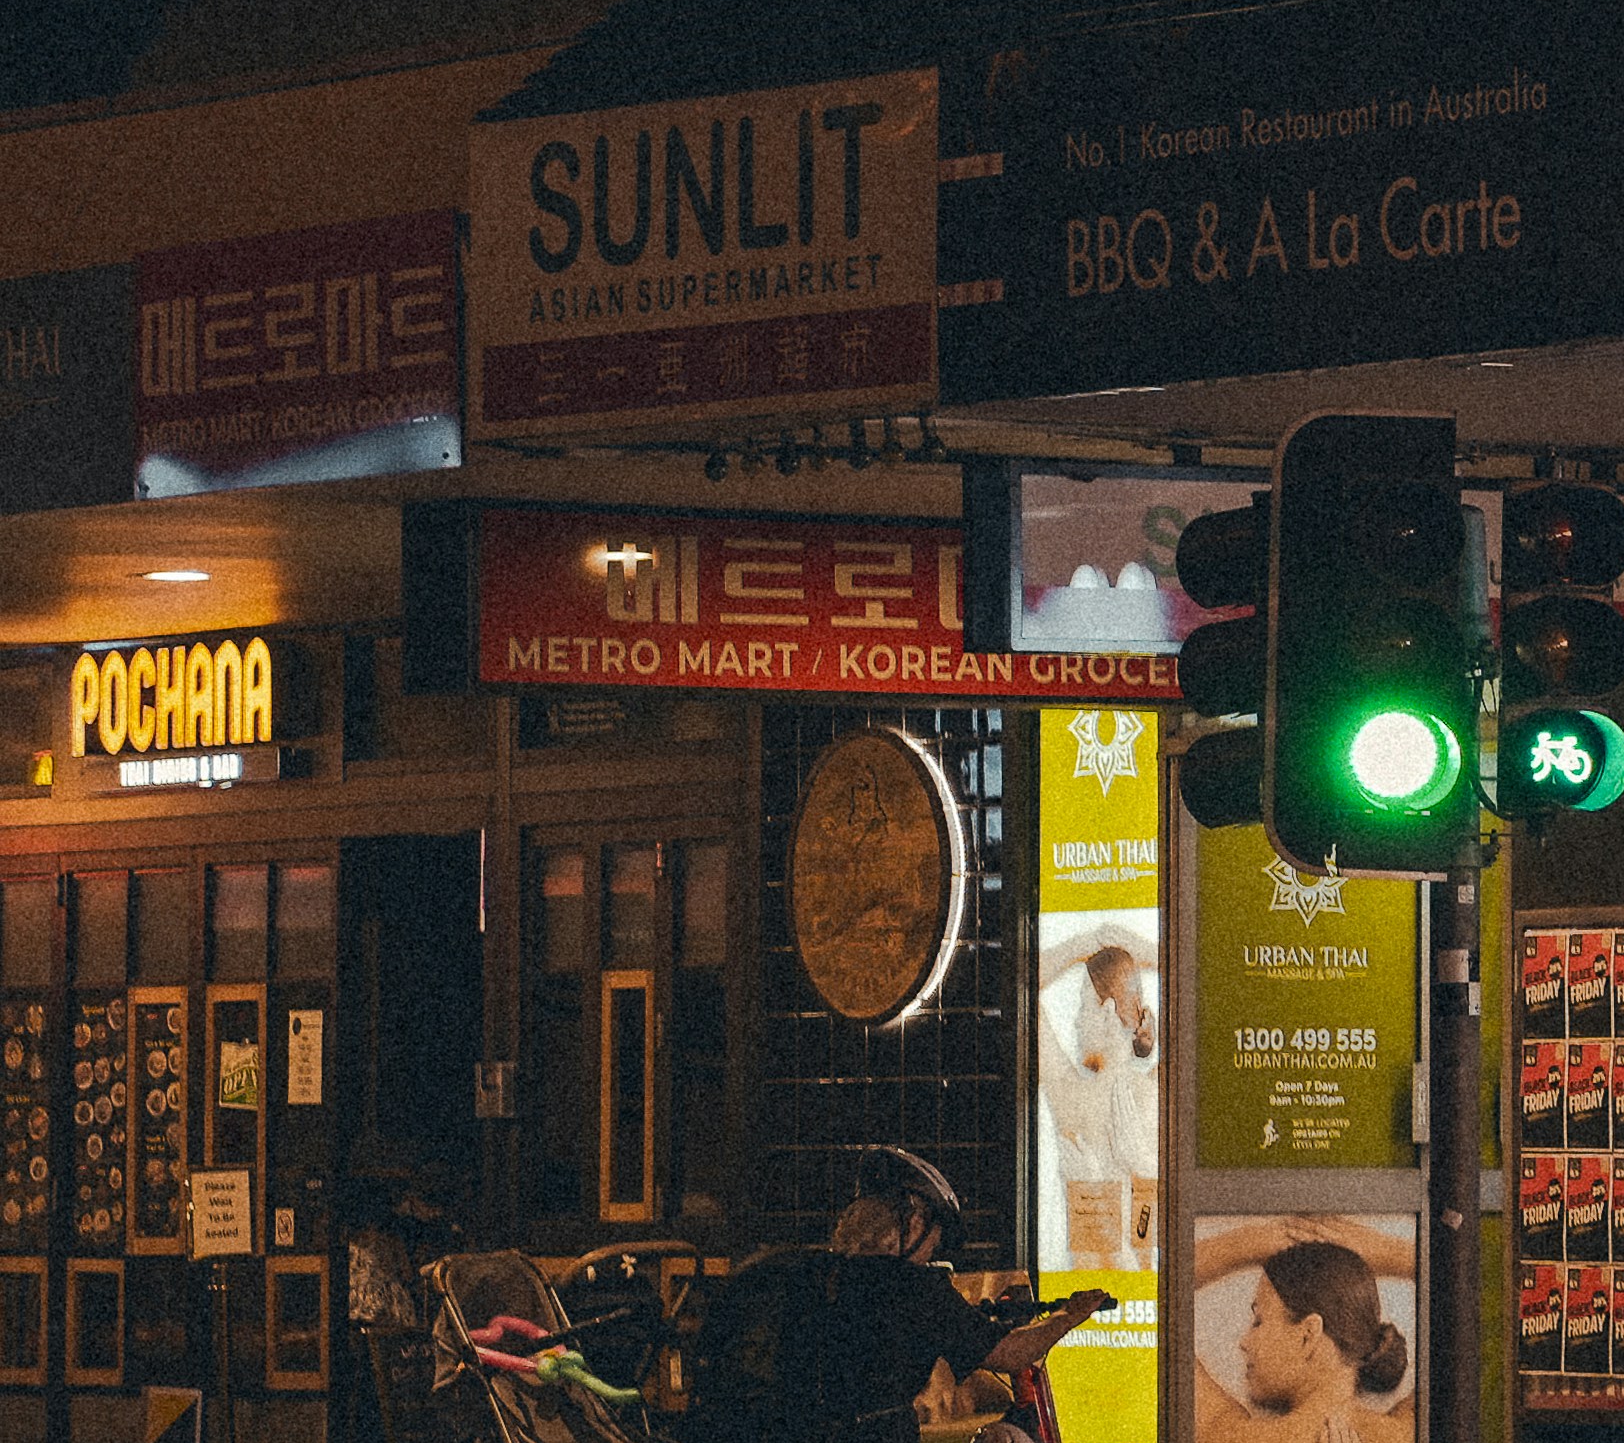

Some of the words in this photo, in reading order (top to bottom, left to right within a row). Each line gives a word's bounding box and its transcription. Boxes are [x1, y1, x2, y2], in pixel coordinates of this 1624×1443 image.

[1140, 120, 1231, 160] Korean
[1240, 97, 1379, 148] Restaurant
[1389, 89, 1413, 129] in
[1423, 66, 1549, 125] Australia
[528, 102, 884, 274] SUNLIT
[1067, 207, 1173, 298] BBQ
[1191, 200, 1232, 284] &
[1246, 193, 1290, 279] A
[1307, 189, 1361, 270] La
[1379, 175, 1523, 262] Carte
[530, 284, 626, 324] ASIAN
[637, 253, 883, 314] SUPERMARKET
[141, 264, 450, 399] 메트로마트
[508, 633, 660, 675] METRO
[678, 639, 804, 678] MART
[838, 643, 1013, 684] KOREAN
[71, 636, 273, 758] POCHANA
[1053, 841, 1111, 868] URBAN
[1115, 837, 1158, 865] THAI
[1243, 944, 1315, 967] URBAN
[1319, 945, 1369, 968] THAI
[1525, 978, 1561, 1006] FRIDAY
[1569, 977, 1607, 1005] FRIDAY
[1234, 1027, 1285, 1052] 1300
[1289, 1027, 1331, 1052] 499
[1336, 1027, 1378, 1052] 555
[1233, 1052, 1378, 1070] URBANTHAI.COM.AU
[1275, 1080, 1304, 1095] Open
[1314, 1080, 1340, 1095] Days
[1523, 1088, 1560, 1115] FRIDAY
[1568, 1087, 1605, 1114] FRIDAY
[1523, 1201, 1561, 1227] FRIDAY
[1567, 1200, 1605, 1228] FRIDAY
[1124, 1299, 1158, 1325] 555
[1522, 1310, 1561, 1337] FRIDAY
[1567, 1314, 1606, 1338] FRIDAY
